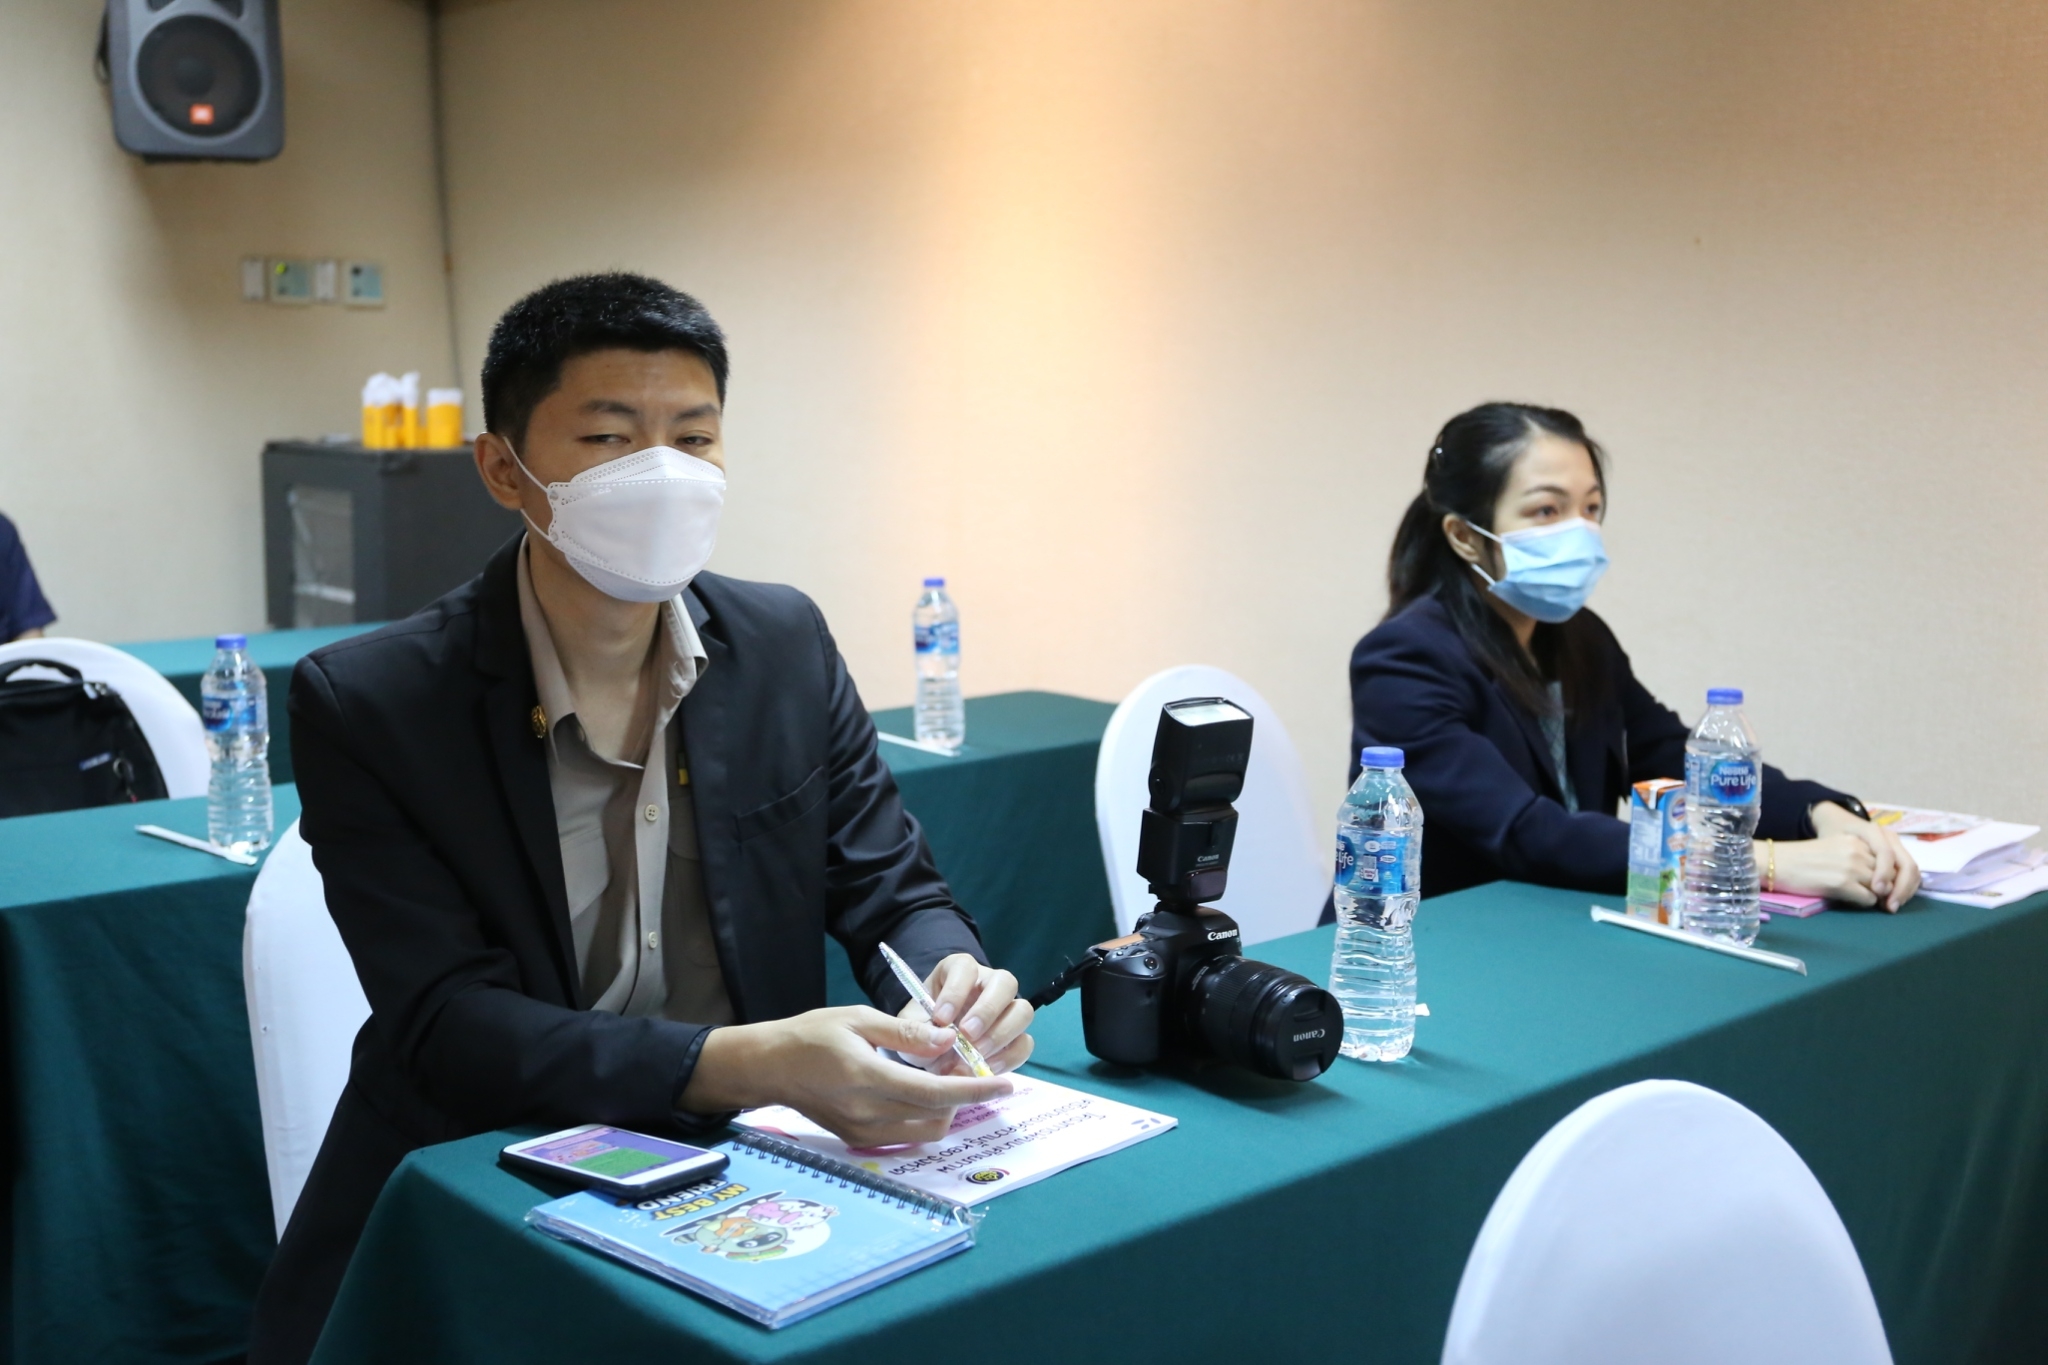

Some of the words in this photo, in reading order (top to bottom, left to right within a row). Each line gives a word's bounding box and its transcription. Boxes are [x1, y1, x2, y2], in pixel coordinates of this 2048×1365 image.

[1711, 774, 1739, 787] Pure
[1740, 774, 1757, 790] Life
[1197, 854, 1219, 862] Canon
[1338, 851, 1354, 869] Life
[1207, 929, 1238, 941] Canon
[1293, 1028, 1326, 1042] Canon
[637, 1179, 728, 1210] FRIEND
[712, 1183, 749, 1201] MY
[653, 1198, 717, 1221] BEST
